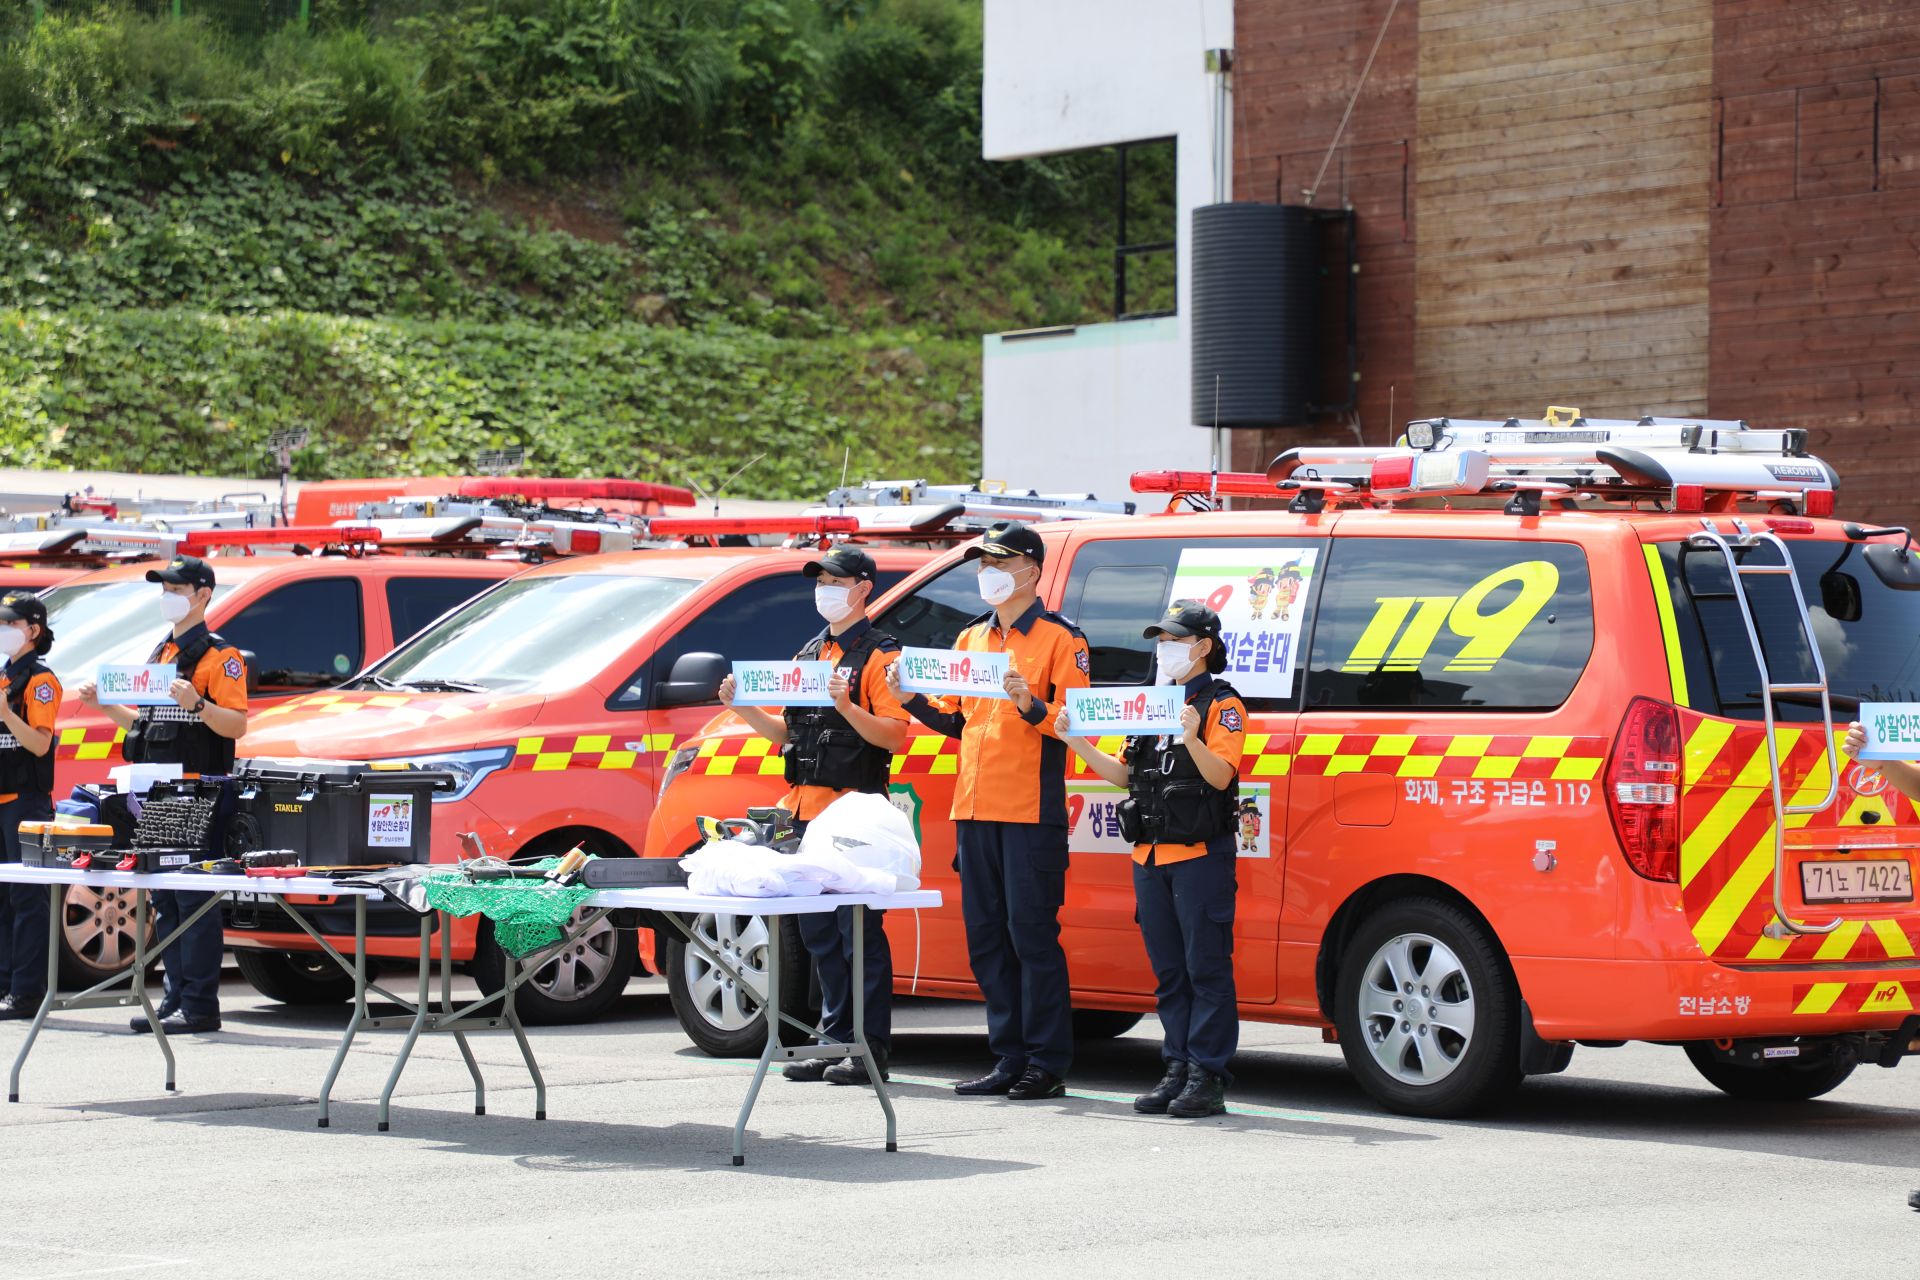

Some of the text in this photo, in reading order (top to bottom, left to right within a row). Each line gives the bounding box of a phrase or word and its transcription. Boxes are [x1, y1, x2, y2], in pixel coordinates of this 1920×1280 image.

[1341, 561, 1559, 673] 119
[1222, 630, 1292, 673] 전순찰대
[904, 656, 948, 681] 생활안전도
[742, 669, 780, 693] 생활안전도
[1076, 697, 1122, 722] 생활안전도
[1404, 779, 1592, 807] 화재, 구조 구급은 119
[274, 803, 303, 813] STANLEY
[372, 805, 391, 818] 119
[371, 820, 410, 832] 생활안전순찰대
[1812, 865, 1902, 893] 71노 7422
[1679, 995, 1752, 1016] 전남소방
[1874, 985, 1899, 1003] 119
